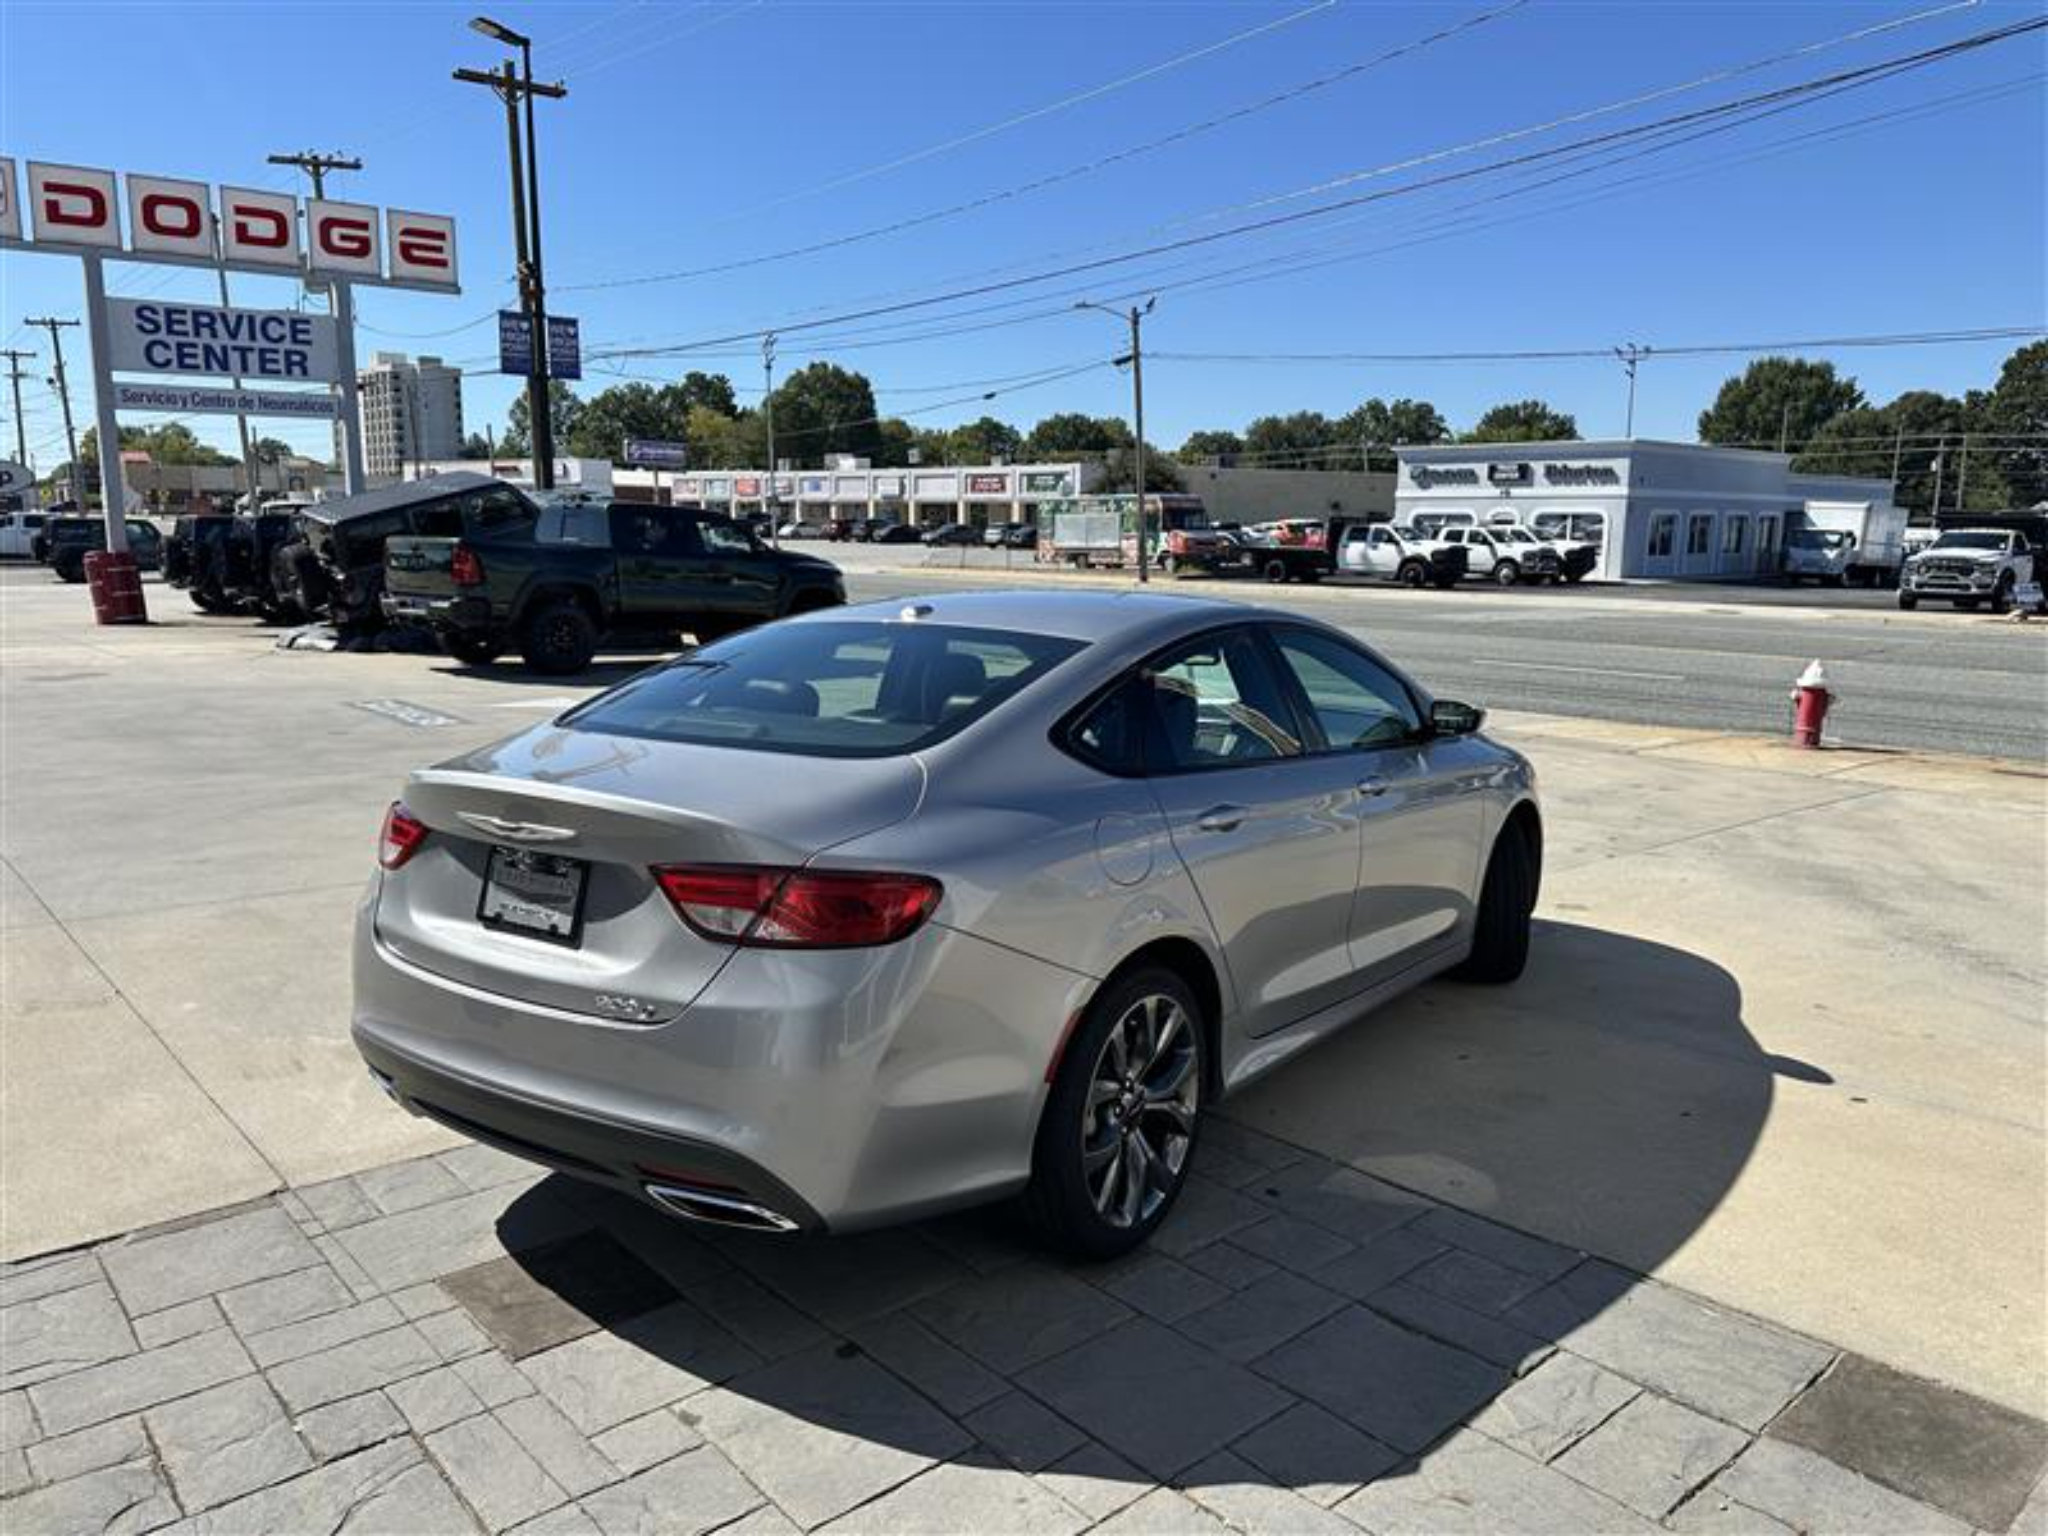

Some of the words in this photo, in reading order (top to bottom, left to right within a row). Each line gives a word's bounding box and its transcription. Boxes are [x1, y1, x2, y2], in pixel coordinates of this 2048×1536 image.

[42, 181, 449, 268] DODGE
[135, 304, 313, 346] SERVICE
[144, 340, 309, 377] CENTER
[121, 389, 179, 405] Servicio
[179, 395, 188, 407] y
[190, 391, 236, 407] Centro
[238, 393, 256, 409] de
